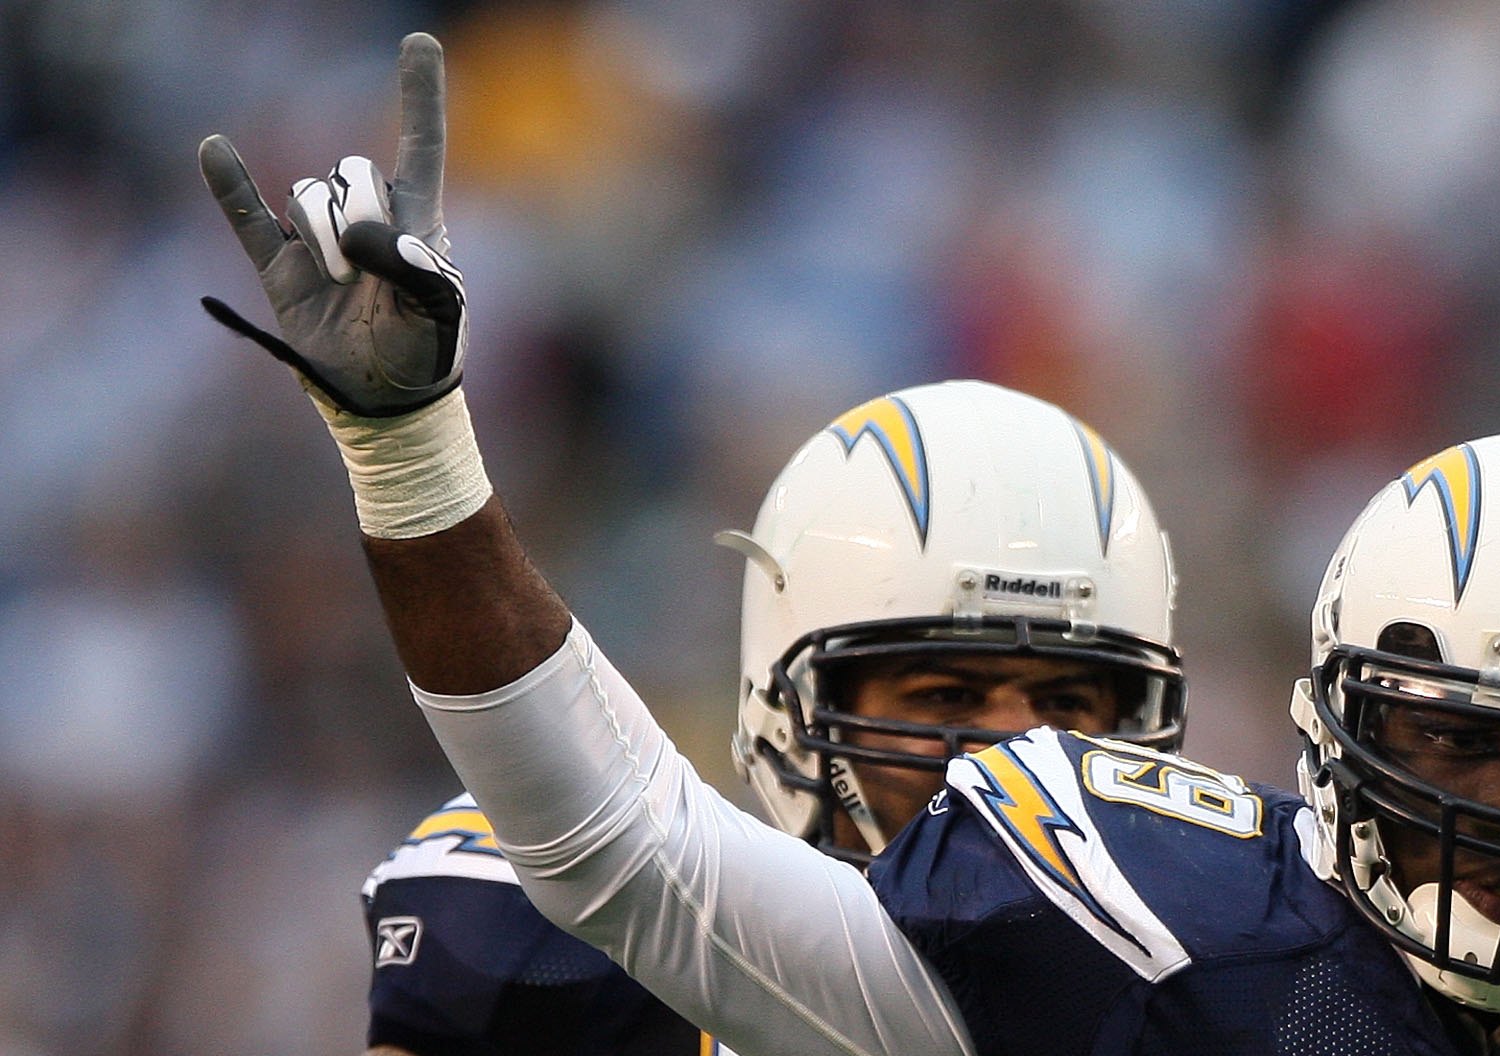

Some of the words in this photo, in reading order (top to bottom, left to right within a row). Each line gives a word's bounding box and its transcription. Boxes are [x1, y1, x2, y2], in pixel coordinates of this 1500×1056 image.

[984, 573, 1061, 599] Riddell
[830, 762, 862, 811] dell
[1067, 730, 1264, 839] 9
